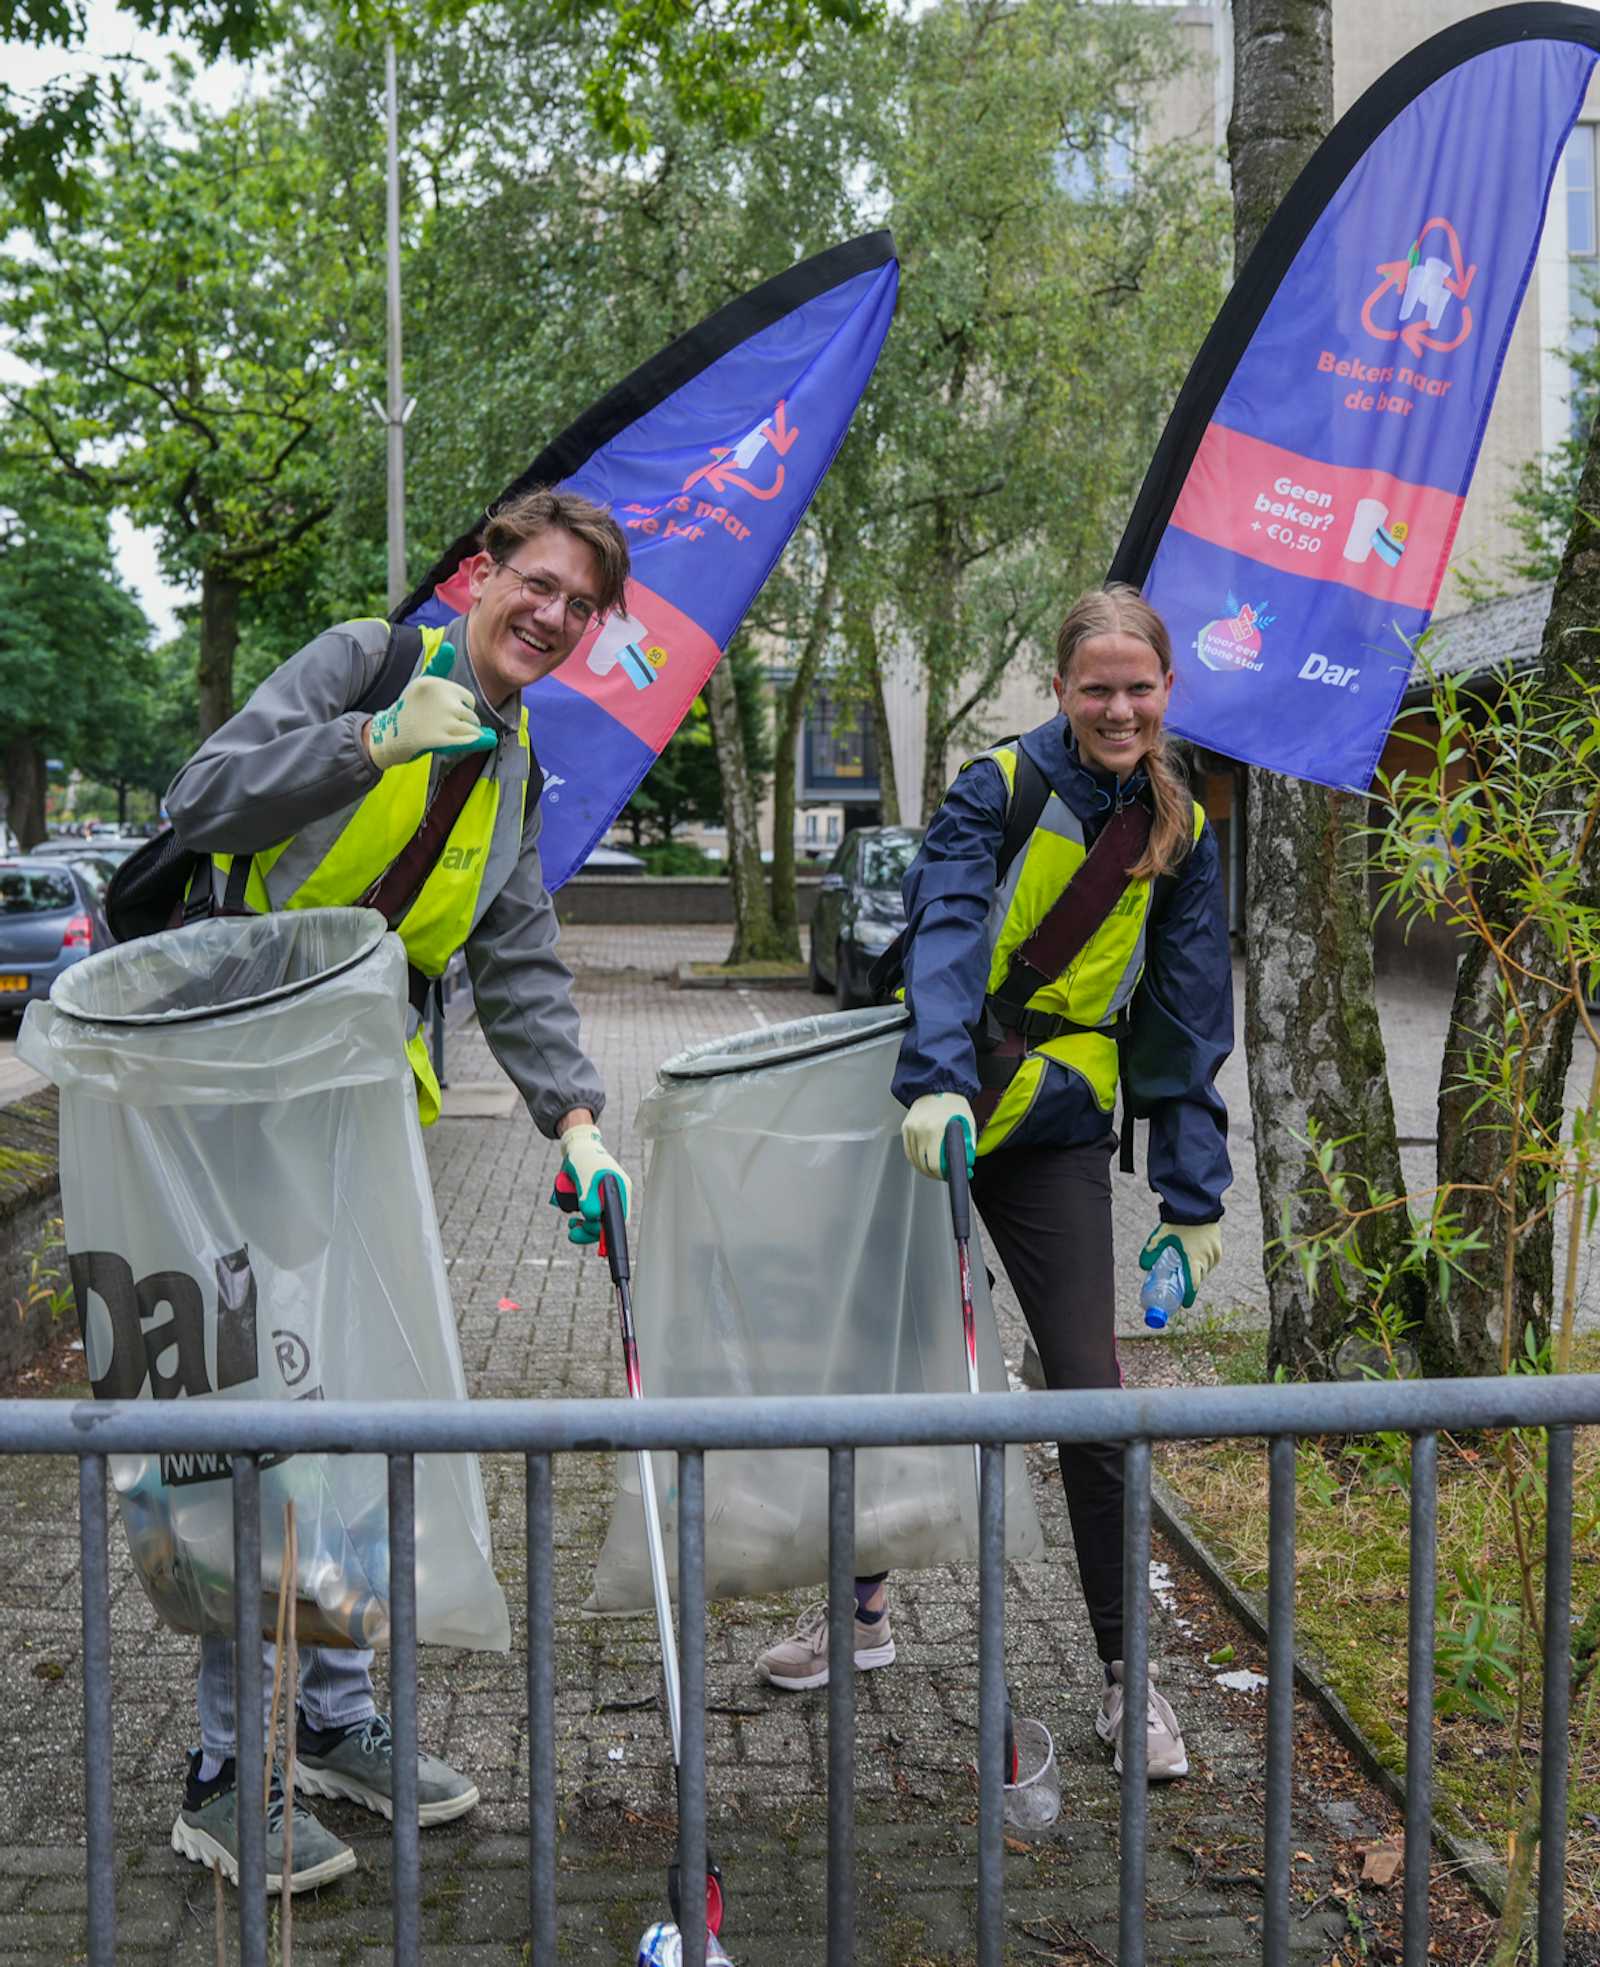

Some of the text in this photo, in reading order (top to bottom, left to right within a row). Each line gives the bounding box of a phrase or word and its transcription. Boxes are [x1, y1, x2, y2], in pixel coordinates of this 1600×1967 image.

[1317, 351, 1453, 397] Bekers naar
[1344, 389, 1414, 416] de bar
[1274, 477, 1333, 508] Geen
[1254, 493, 1335, 531] beker?
[1266, 524, 1321, 553] €0,50
[1207, 634, 1259, 659] voor een
[1234, 654, 1264, 672] stad
[443, 846, 482, 870] ar
